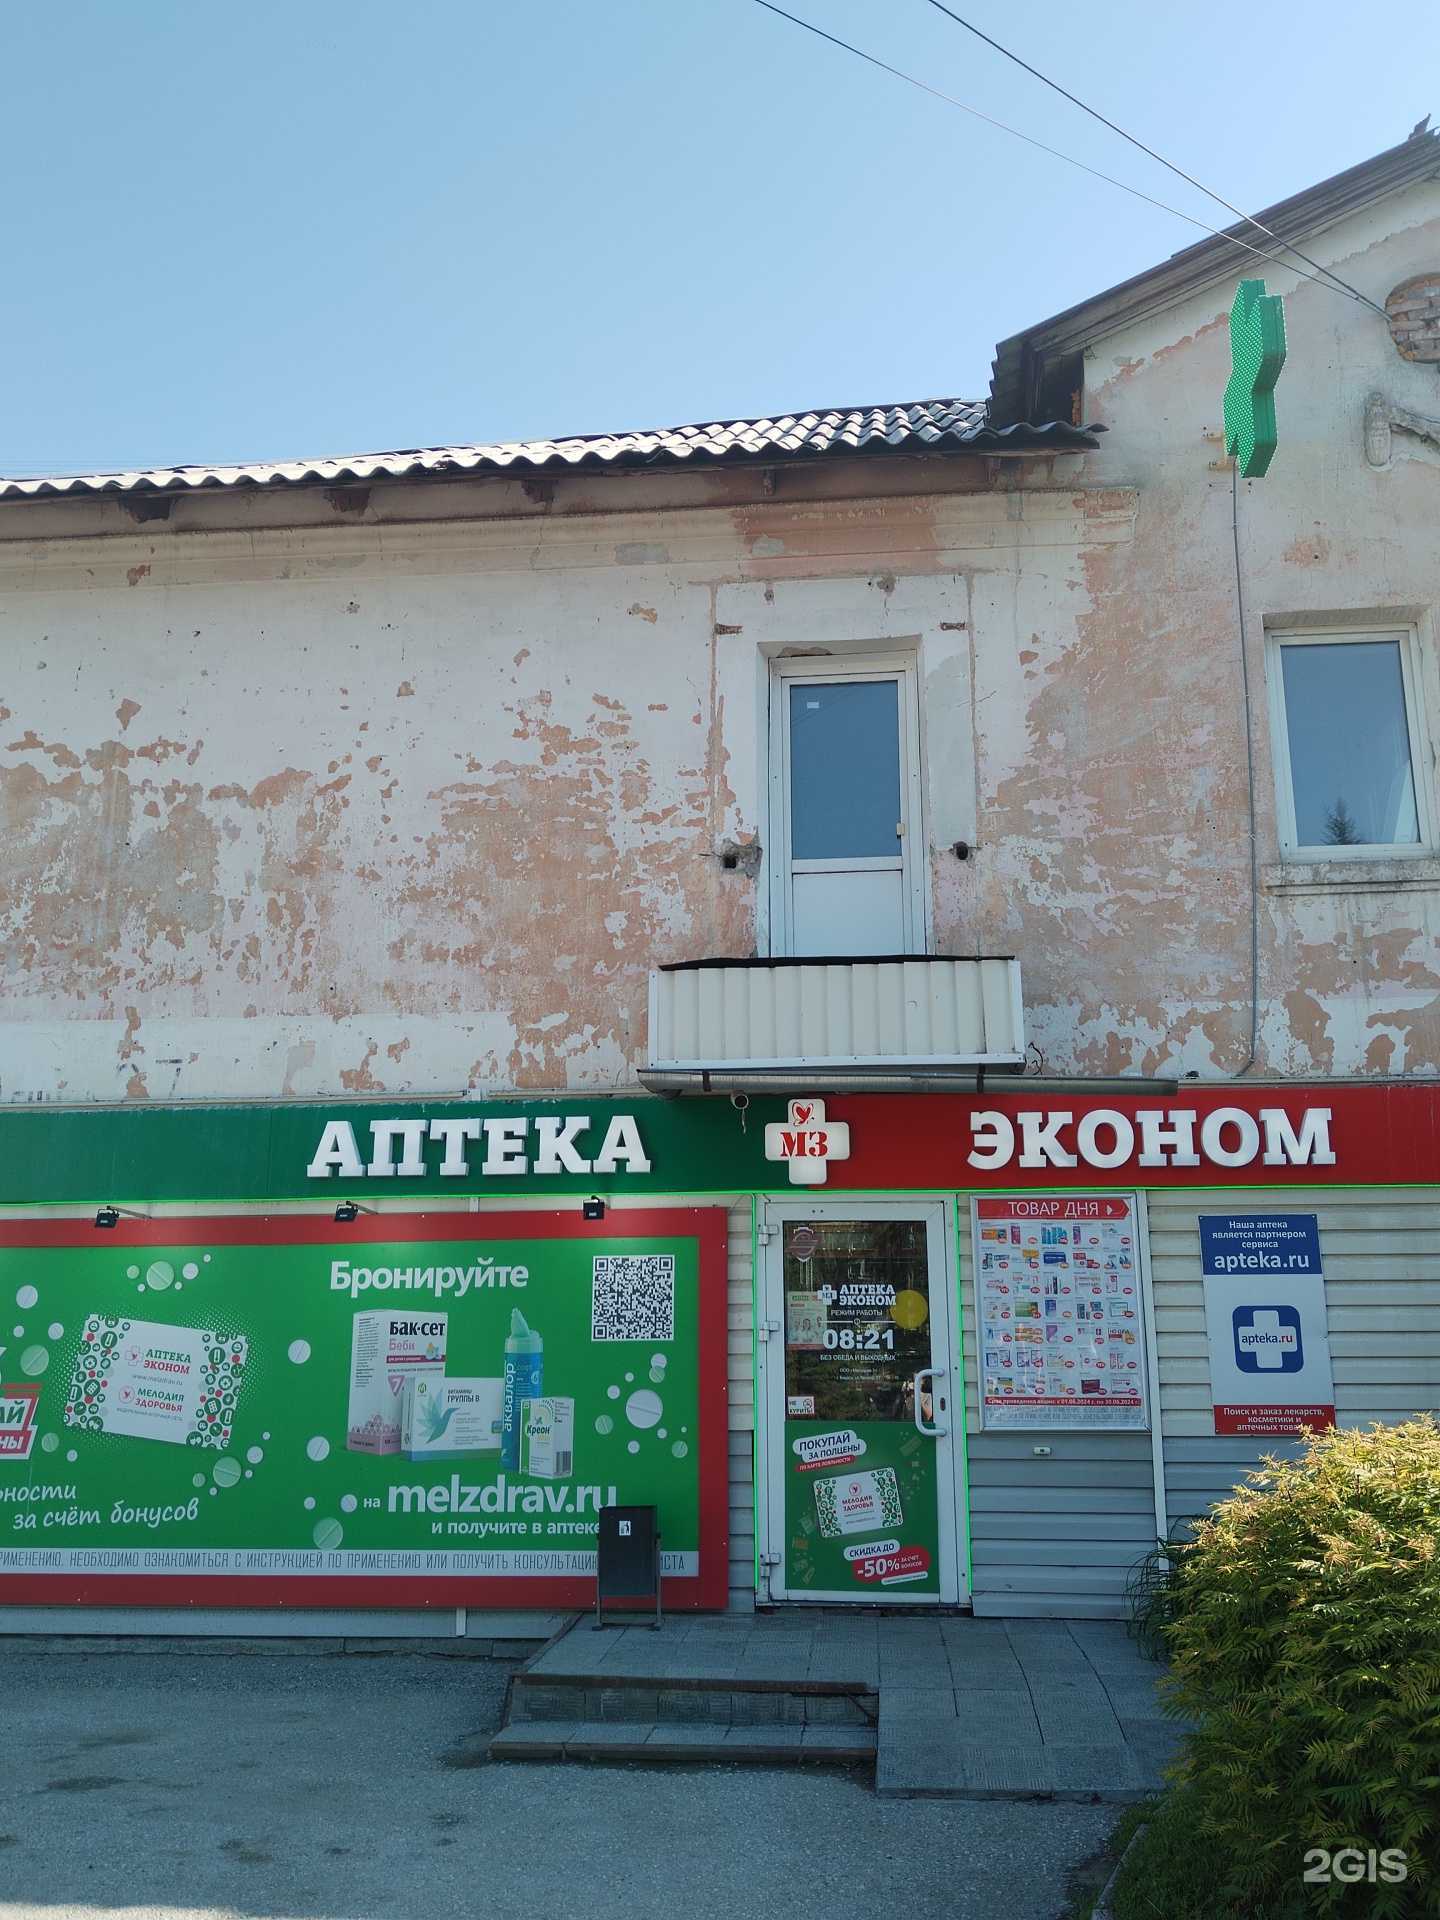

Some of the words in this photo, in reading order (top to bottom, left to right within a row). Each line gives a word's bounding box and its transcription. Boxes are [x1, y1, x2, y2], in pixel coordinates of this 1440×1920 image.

[780, 1131, 828, 1157] МЗ
[968, 1107, 1337, 1170] ЭКОНОМ
[306, 1115, 652, 1178] АПТЕКА
[1008, 1202, 1059, 1216] ТОВАР
[1064, 1202, 1099, 1218] ДНЯ
[1229, 1221, 1255, 1229] Наша
[1257, 1221, 1288, 1230] аптека
[1212, 1231, 1253, 1239] является
[1255, 1231, 1306, 1240] партнером
[1241, 1240, 1279, 1249] сервиса
[1214, 1251, 1310, 1272] apteka.ru
[329, 1259, 530, 1297] Бронируйте
[839, 1284, 896, 1295] АПТЕКА
[839, 1295, 897, 1306] ЭКОНОМ
[822, 1329, 894, 1350] 08:21
[1241, 1332, 1293, 1346] apteka.ru
[145, 1348, 191, 1363] АПТЕКА
[143, 1360, 190, 1374] ЭКОНОМ
[137, 1387, 185, 1402] МЕЛОДИЯ
[504, 1362, 516, 1432] аквалор
[135, 1398, 183, 1412] ЗДОРОВЬЯ
[1223, 1407, 1250, 1416] Поиск
[1251, 1408, 1257, 1416] и
[1259, 1408, 1282, 1416] заказ
[526, 1424, 551, 1437] Креон
[1236, 1424, 1278, 1433] аптечных
[799, 1432, 850, 1451] ПОКУПАЙ
[808, 1451, 820, 1460] ЗА
[820, 1443, 860, 1457] ПОЛЦЕНЫ
[363, 1498, 381, 1508] на
[388, 1474, 617, 1513] melzdrav.ru
[13, 1513, 37, 1530] за
[43, 1506, 101, 1527] счёт
[110, 1497, 199, 1528] бонусов
[431, 1522, 442, 1534] и
[447, 1522, 527, 1538] получите
[532, 1522, 542, 1534] в
[849, 1545, 882, 1558] СКИДКА
[882, 1543, 895, 1553] ДО
[70, 1551, 139, 1568] НЕОБХОДИМО
[144, 1551, 229, 1568] ОЗНАКОМИТЬСЯ
[234, 1552, 242, 1568] С
[246, 1550, 323, 1569] ИНСТРУКЦИЕЙ
[328, 1552, 342, 1568] ПО
[347, 1552, 421, 1569] ПРИМЕНЕНИЮ
[425, 1552, 448, 1569] ИЛИ
[452, 1552, 509, 1570] ПОЛУЧИТЬ
